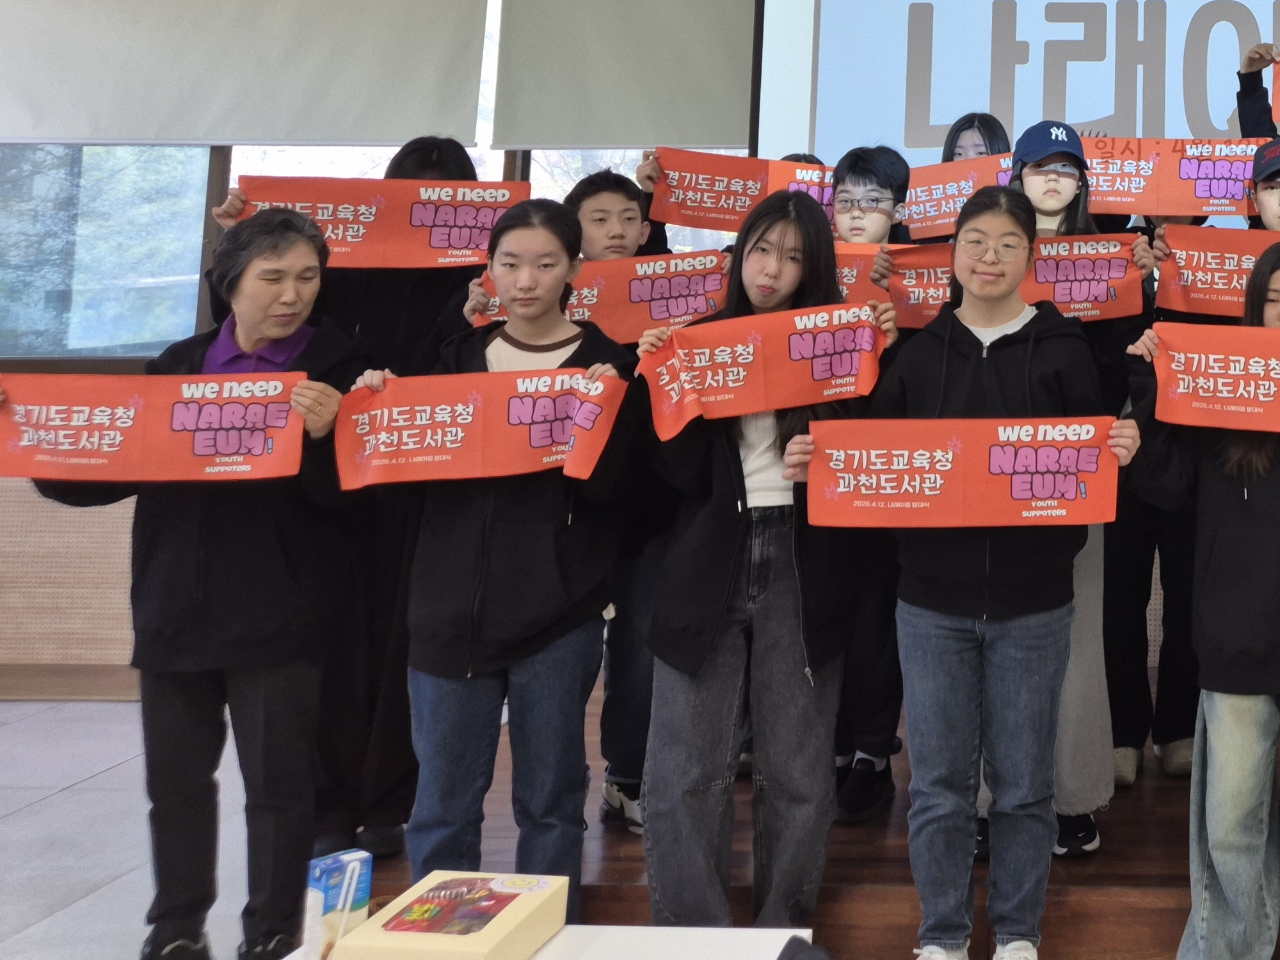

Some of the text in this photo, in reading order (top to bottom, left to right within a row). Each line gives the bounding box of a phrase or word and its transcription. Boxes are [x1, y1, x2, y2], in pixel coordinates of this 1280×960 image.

[1187, 145, 1212, 156] we
[796, 169, 822, 182] we
[1087, 159, 1153, 176] 도교육청
[664, 170, 762, 195] 경기도교육청
[906, 180, 974, 202] 기도교육청
[419, 188, 453, 201] we
[670, 188, 752, 212] 과천도서관
[429, 227, 491, 250] EUM
[1039, 243, 1069, 256] we
[636, 261, 666, 275] we
[1034, 258, 1128, 283] NARAE
[1171, 248, 1258, 271] 경기도교육
[629, 273, 723, 303] NARAE
[1179, 269, 1247, 291] 과천도서
[1053, 281, 1116, 303] EUM!
[650, 295, 716, 321] EUM!
[794, 313, 829, 329] we
[181, 382, 219, 398] we
[516, 375, 552, 393] we
[1177, 374, 1277, 402] 과천도서관
[13, 404, 136, 427] 경기도교육청
[171, 402, 290, 431] NARAE
[352, 403, 475, 433] 경기도교육청
[19, 428, 124, 452] 과천도서관
[193, 429, 273, 456] EUM!
[363, 427, 464, 455] 과천도서관
[998, 425, 1033, 442] we
[825, 449, 953, 472] 경기도교육청
[988, 444, 1100, 475] NARAE
[836, 473, 944, 496] 과천도서관
[1010, 473, 1087, 500] EUM!
